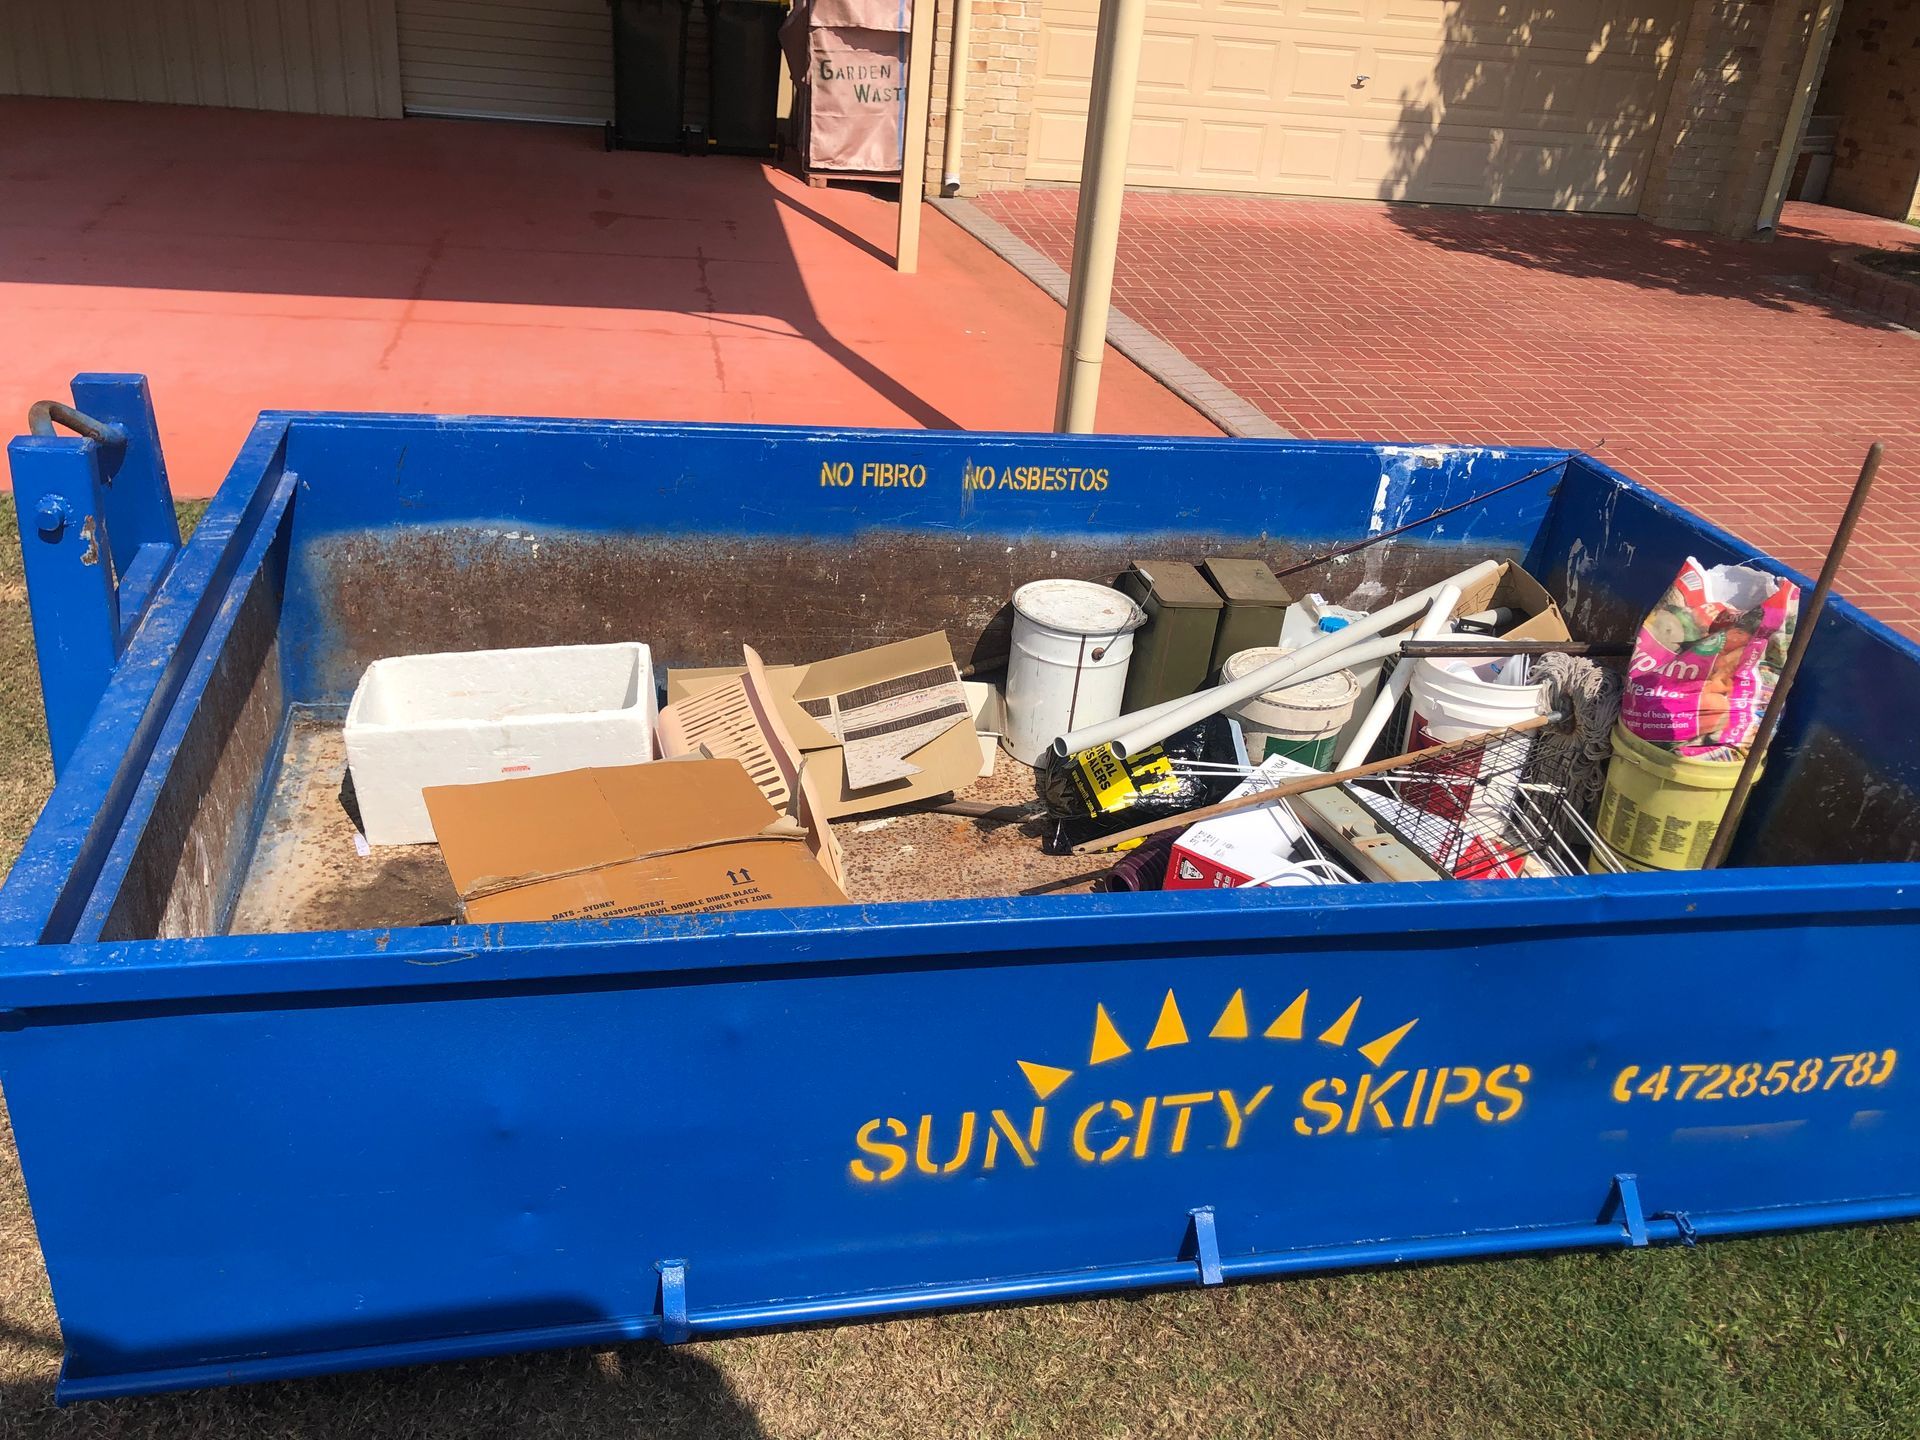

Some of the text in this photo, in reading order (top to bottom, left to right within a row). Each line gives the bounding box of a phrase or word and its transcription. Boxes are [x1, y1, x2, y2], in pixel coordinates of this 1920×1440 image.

[820, 60, 891, 80] GARDEN
[854, 84, 907, 103] WAST
[821, 461, 927, 488] NO FIBRO
[964, 465, 1109, 491] NO ASBESTOS
[1643, 720, 1689, 730] penetration
[1652, 711, 1674, 720] heavy
[1085, 750, 1111, 791] SALERS
[1093, 745, 1118, 778] RICAL
[551, 910, 575, 921] DATS
[583, 900, 616, 913] SYDNEY
[644, 906, 669, 917] BOWL
[670, 899, 704, 911] DOUBLE
[706, 893, 731, 904] DINER
[733, 887, 760, 898] BLACK
[702, 901, 732, 912] BOWLS
[735, 897, 751, 906] PET
[752, 893, 773, 903] ZONE
[850, 1063, 1531, 1182] SUN CITY SKIPS
